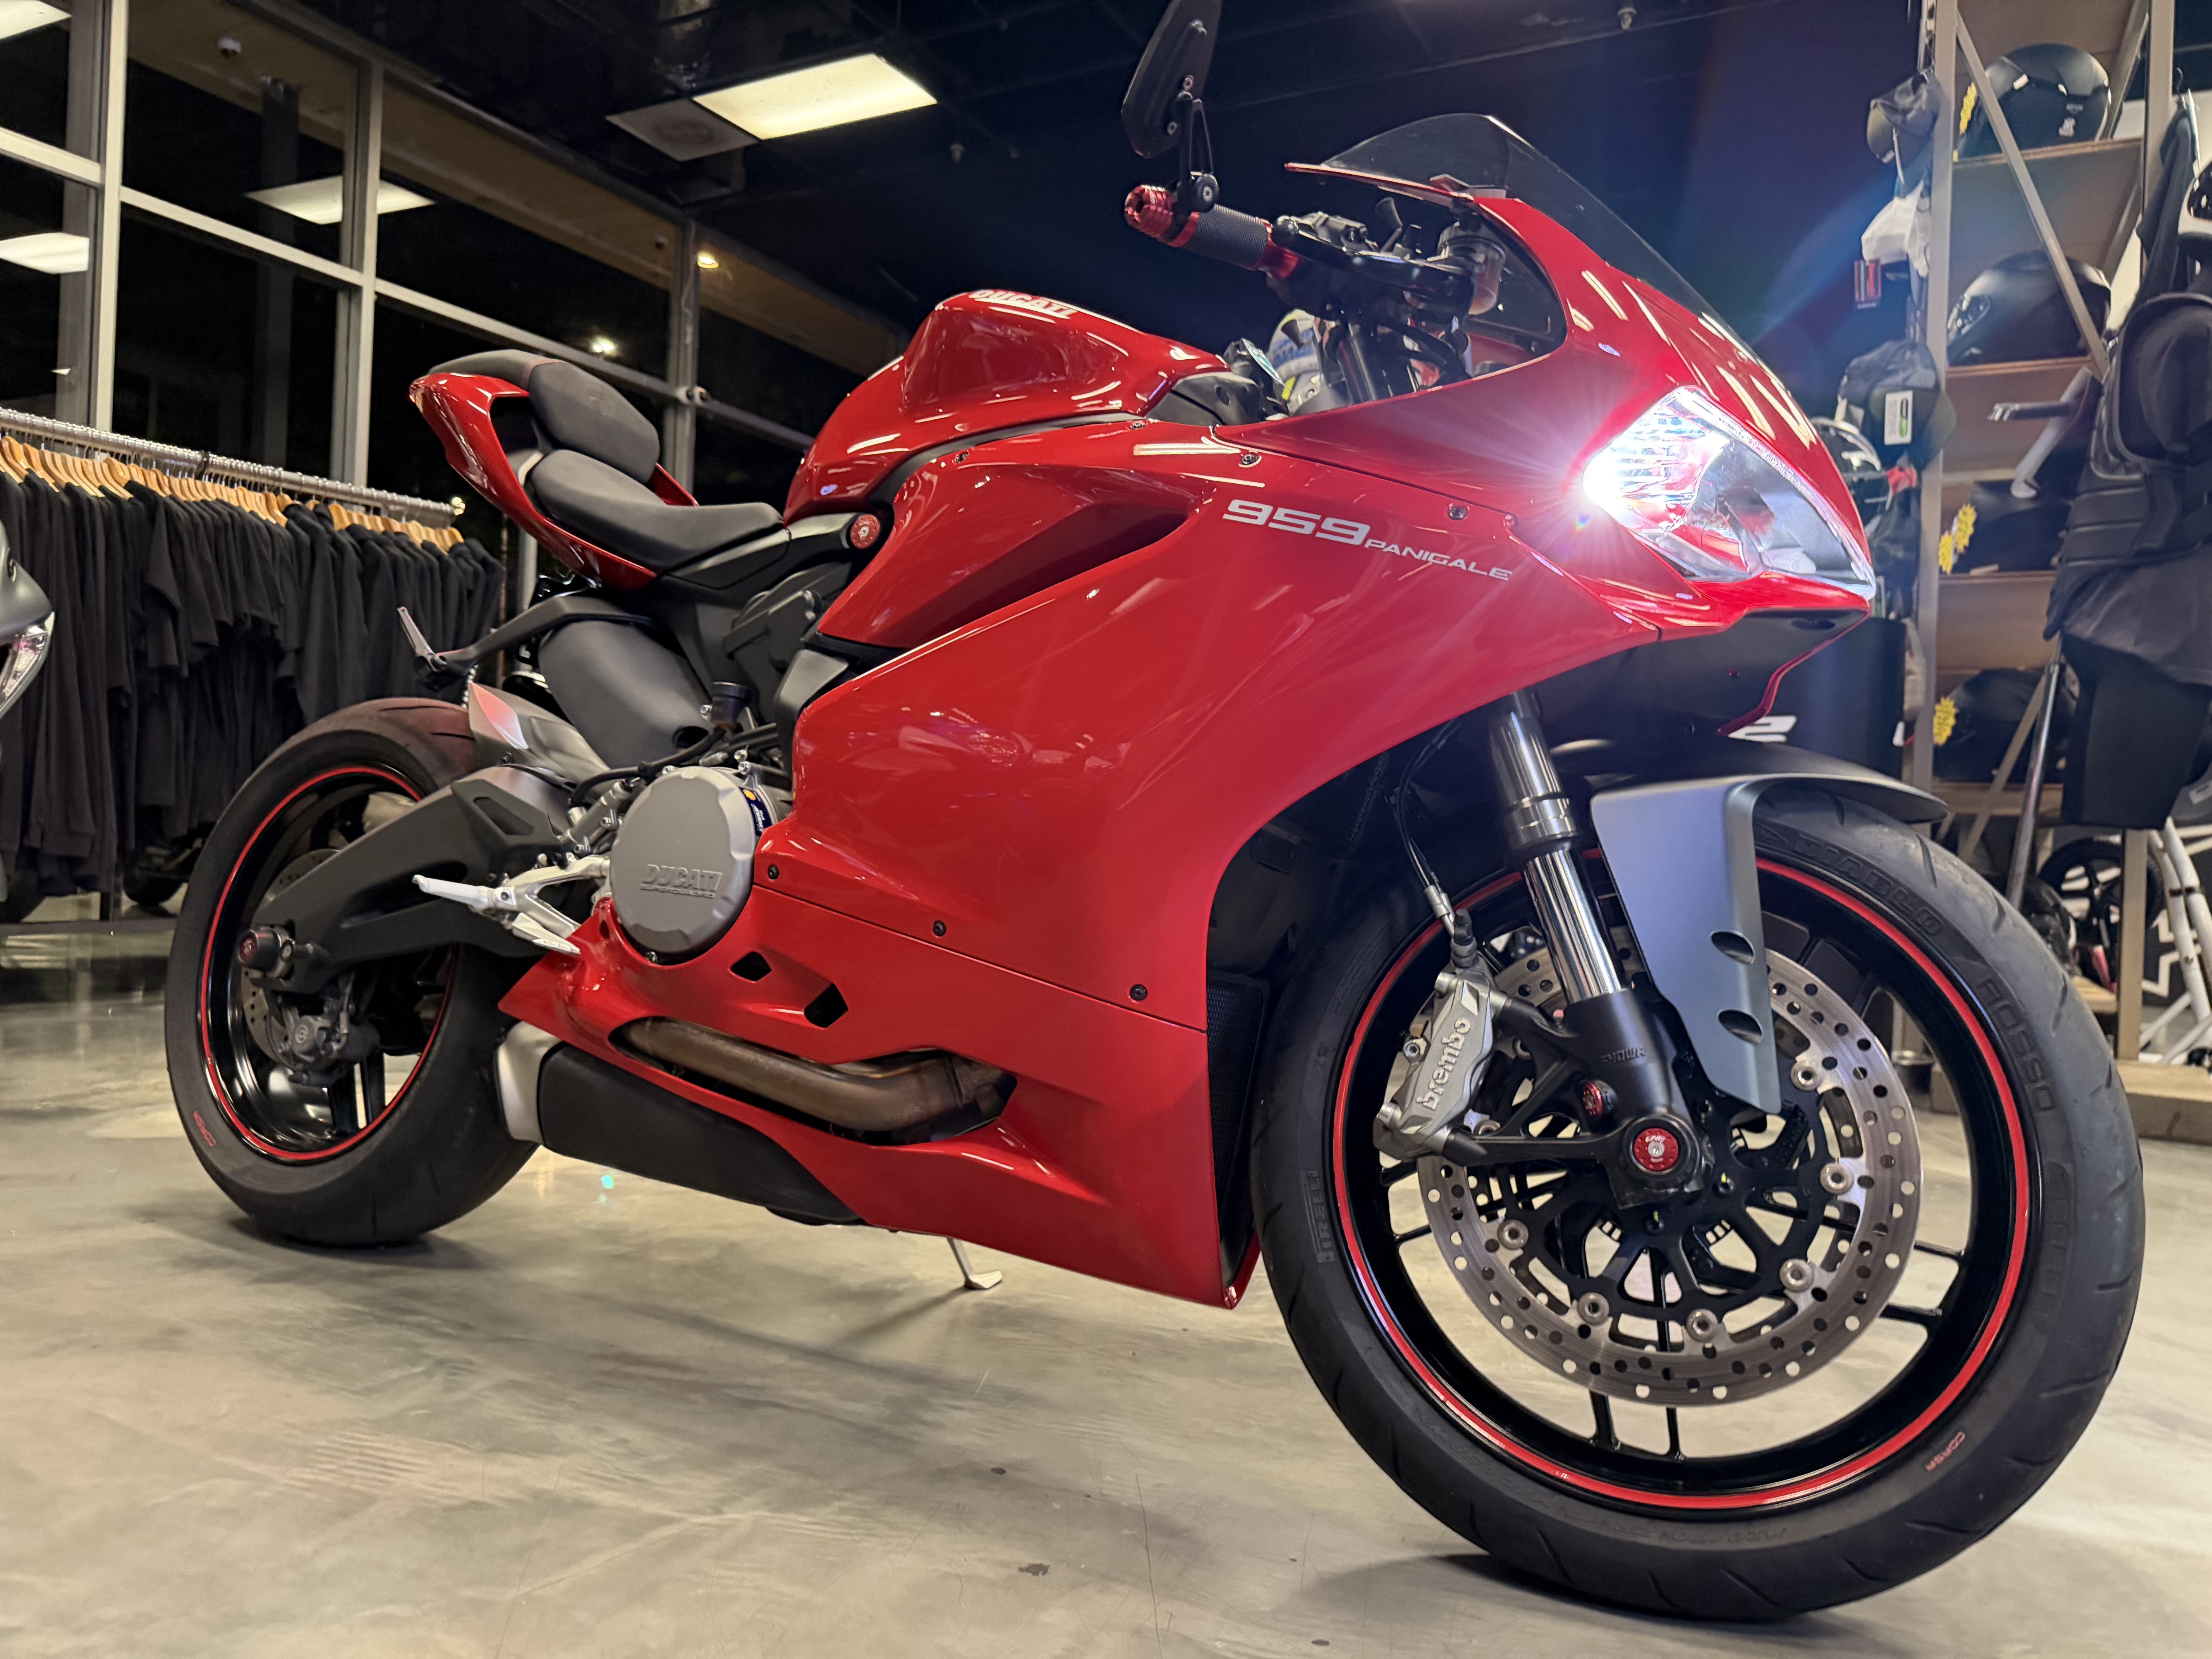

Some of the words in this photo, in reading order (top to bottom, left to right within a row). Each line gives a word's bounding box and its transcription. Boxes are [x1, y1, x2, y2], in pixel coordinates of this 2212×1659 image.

[968, 290, 1077, 316] DUCATI
[1223, 499, 1370, 545] 959
[1364, 539, 1512, 580] PANIGALE
[642, 864, 723, 892] DUCATI
[1416, 1018, 1471, 1111] brembo
[1925, 1432, 1966, 1471] CORSA
